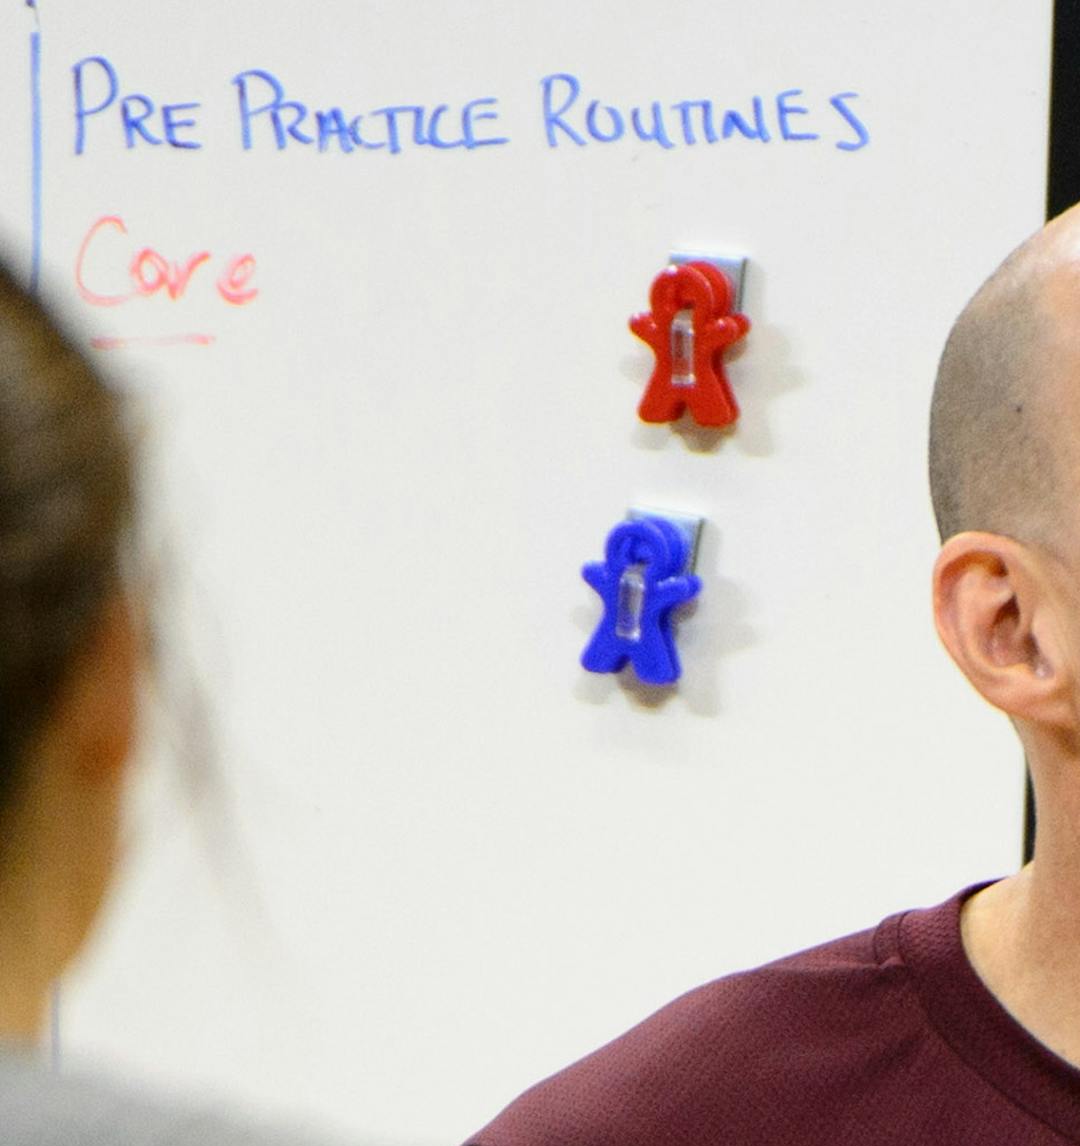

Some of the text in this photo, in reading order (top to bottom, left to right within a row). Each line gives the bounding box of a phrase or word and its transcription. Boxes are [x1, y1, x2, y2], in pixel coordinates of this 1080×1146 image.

[72, 55, 871, 156] PRE PRACTICE ROUTINES
